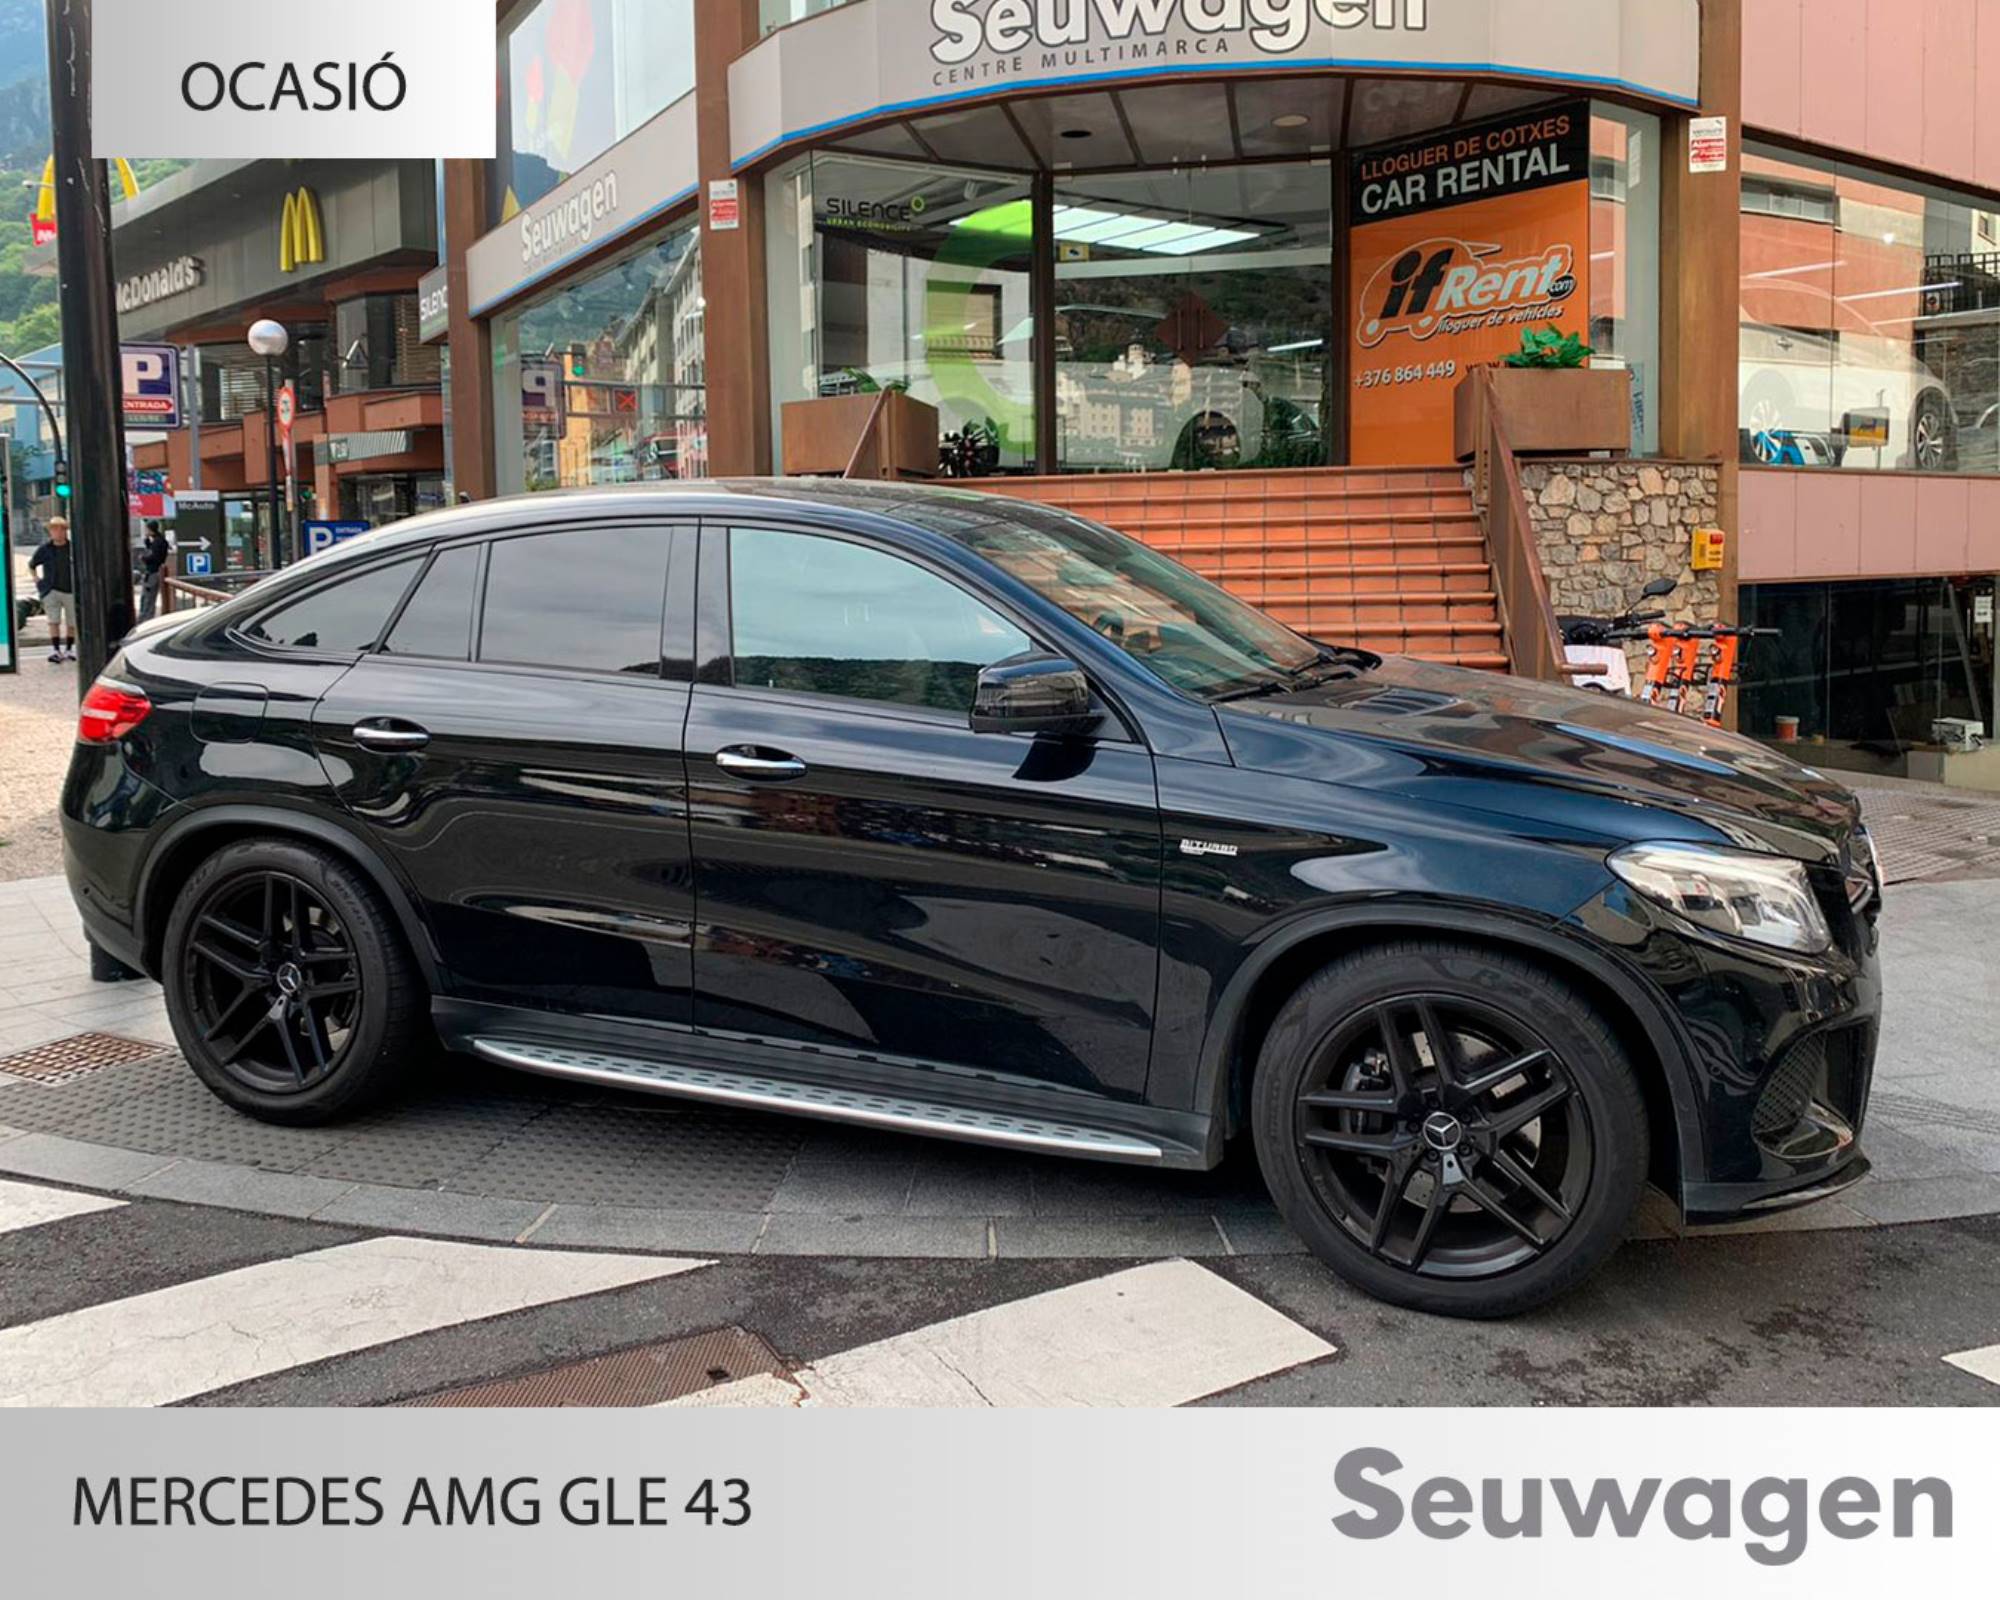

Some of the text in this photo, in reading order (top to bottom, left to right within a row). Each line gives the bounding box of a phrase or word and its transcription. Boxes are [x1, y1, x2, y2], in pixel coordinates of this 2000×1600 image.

[929, 0, 1429, 65] Seuwagen
[932, 38, 1230, 87] CENTRE MULTIMARCA
[1361, 115, 1571, 181] LLOGUER DE COTXES
[1360, 143, 1570, 214] CAR RENTAL
[521, 171, 617, 263] Seuwagen
[826, 198, 911, 222] SILENCE
[1437, 305, 1565, 335] lloguer de vehicles
[121, 353, 162, 394] P
[1355, 367, 1392, 388] +376
[1395, 364, 1424, 384] 864
[1426, 360, 1457, 379] 449
[123, 400, 167, 409] NTRADA
[309, 527, 334, 556] P
[194, 556, 206, 572] P
